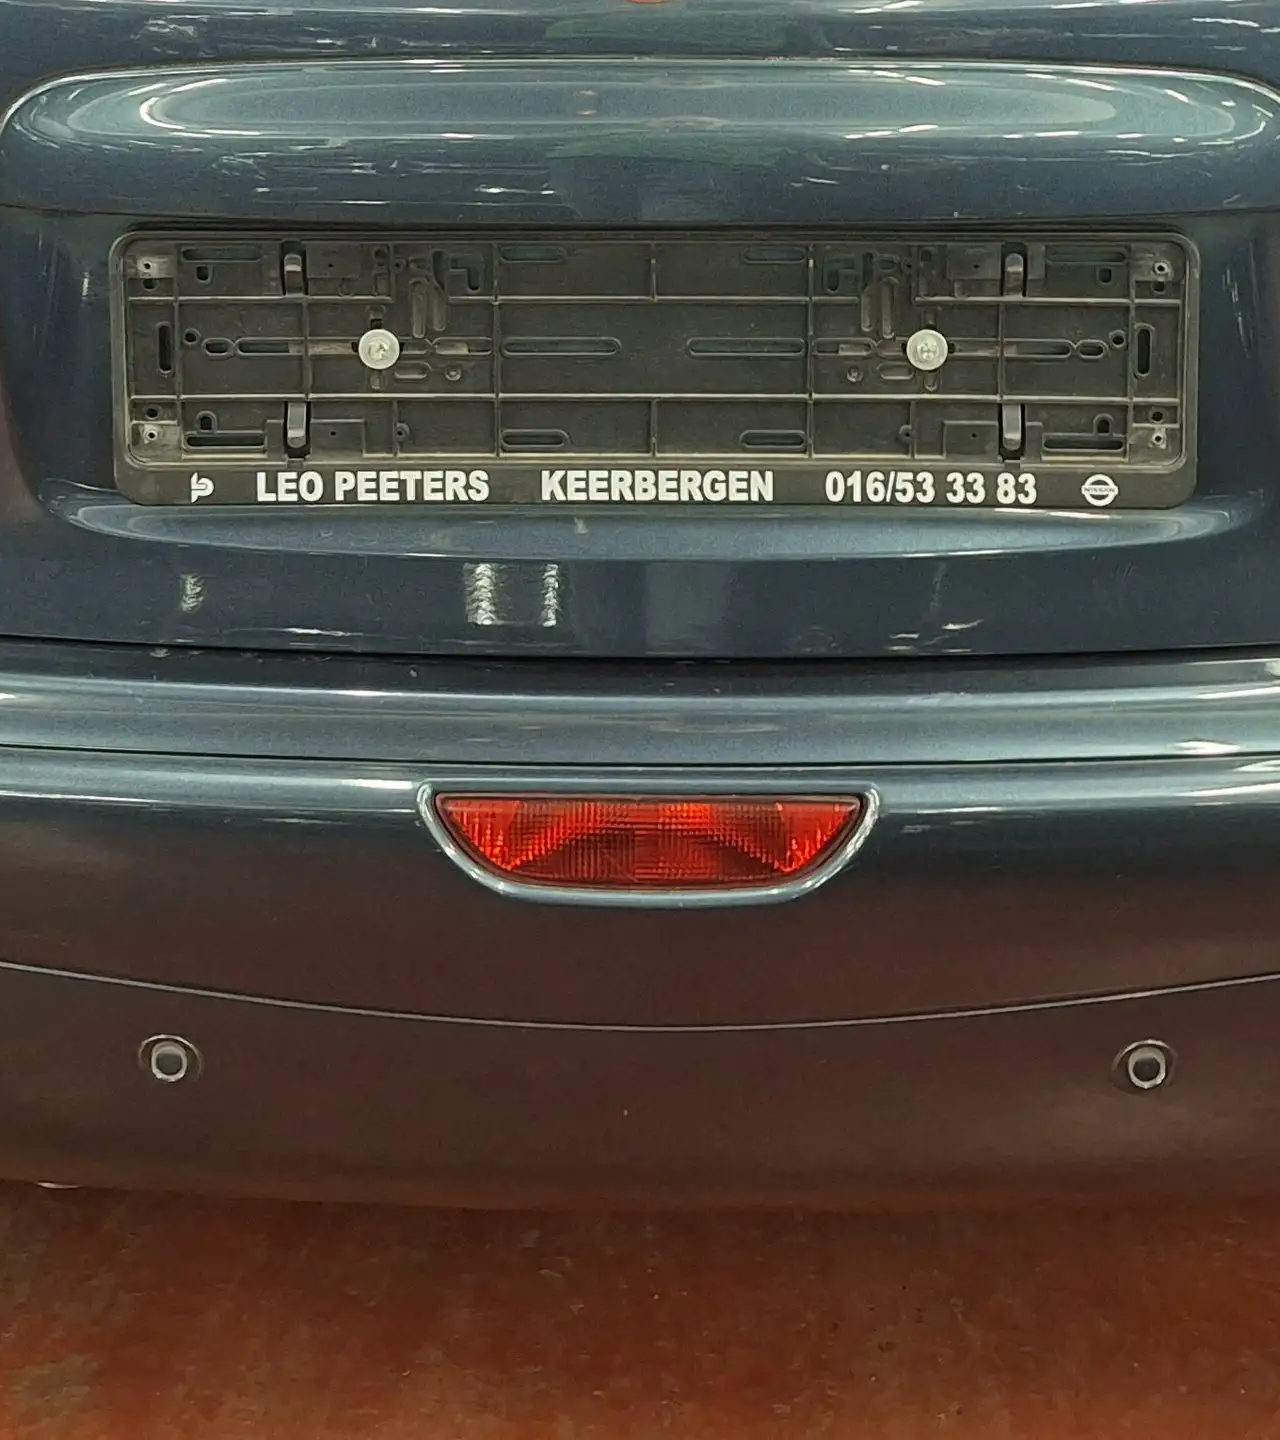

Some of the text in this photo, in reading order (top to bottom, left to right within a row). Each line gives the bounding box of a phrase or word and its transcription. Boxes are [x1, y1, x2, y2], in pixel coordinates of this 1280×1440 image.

[256, 470, 1037, 505] LEO PEETERS KEERBERGEN 016/53 33 83
